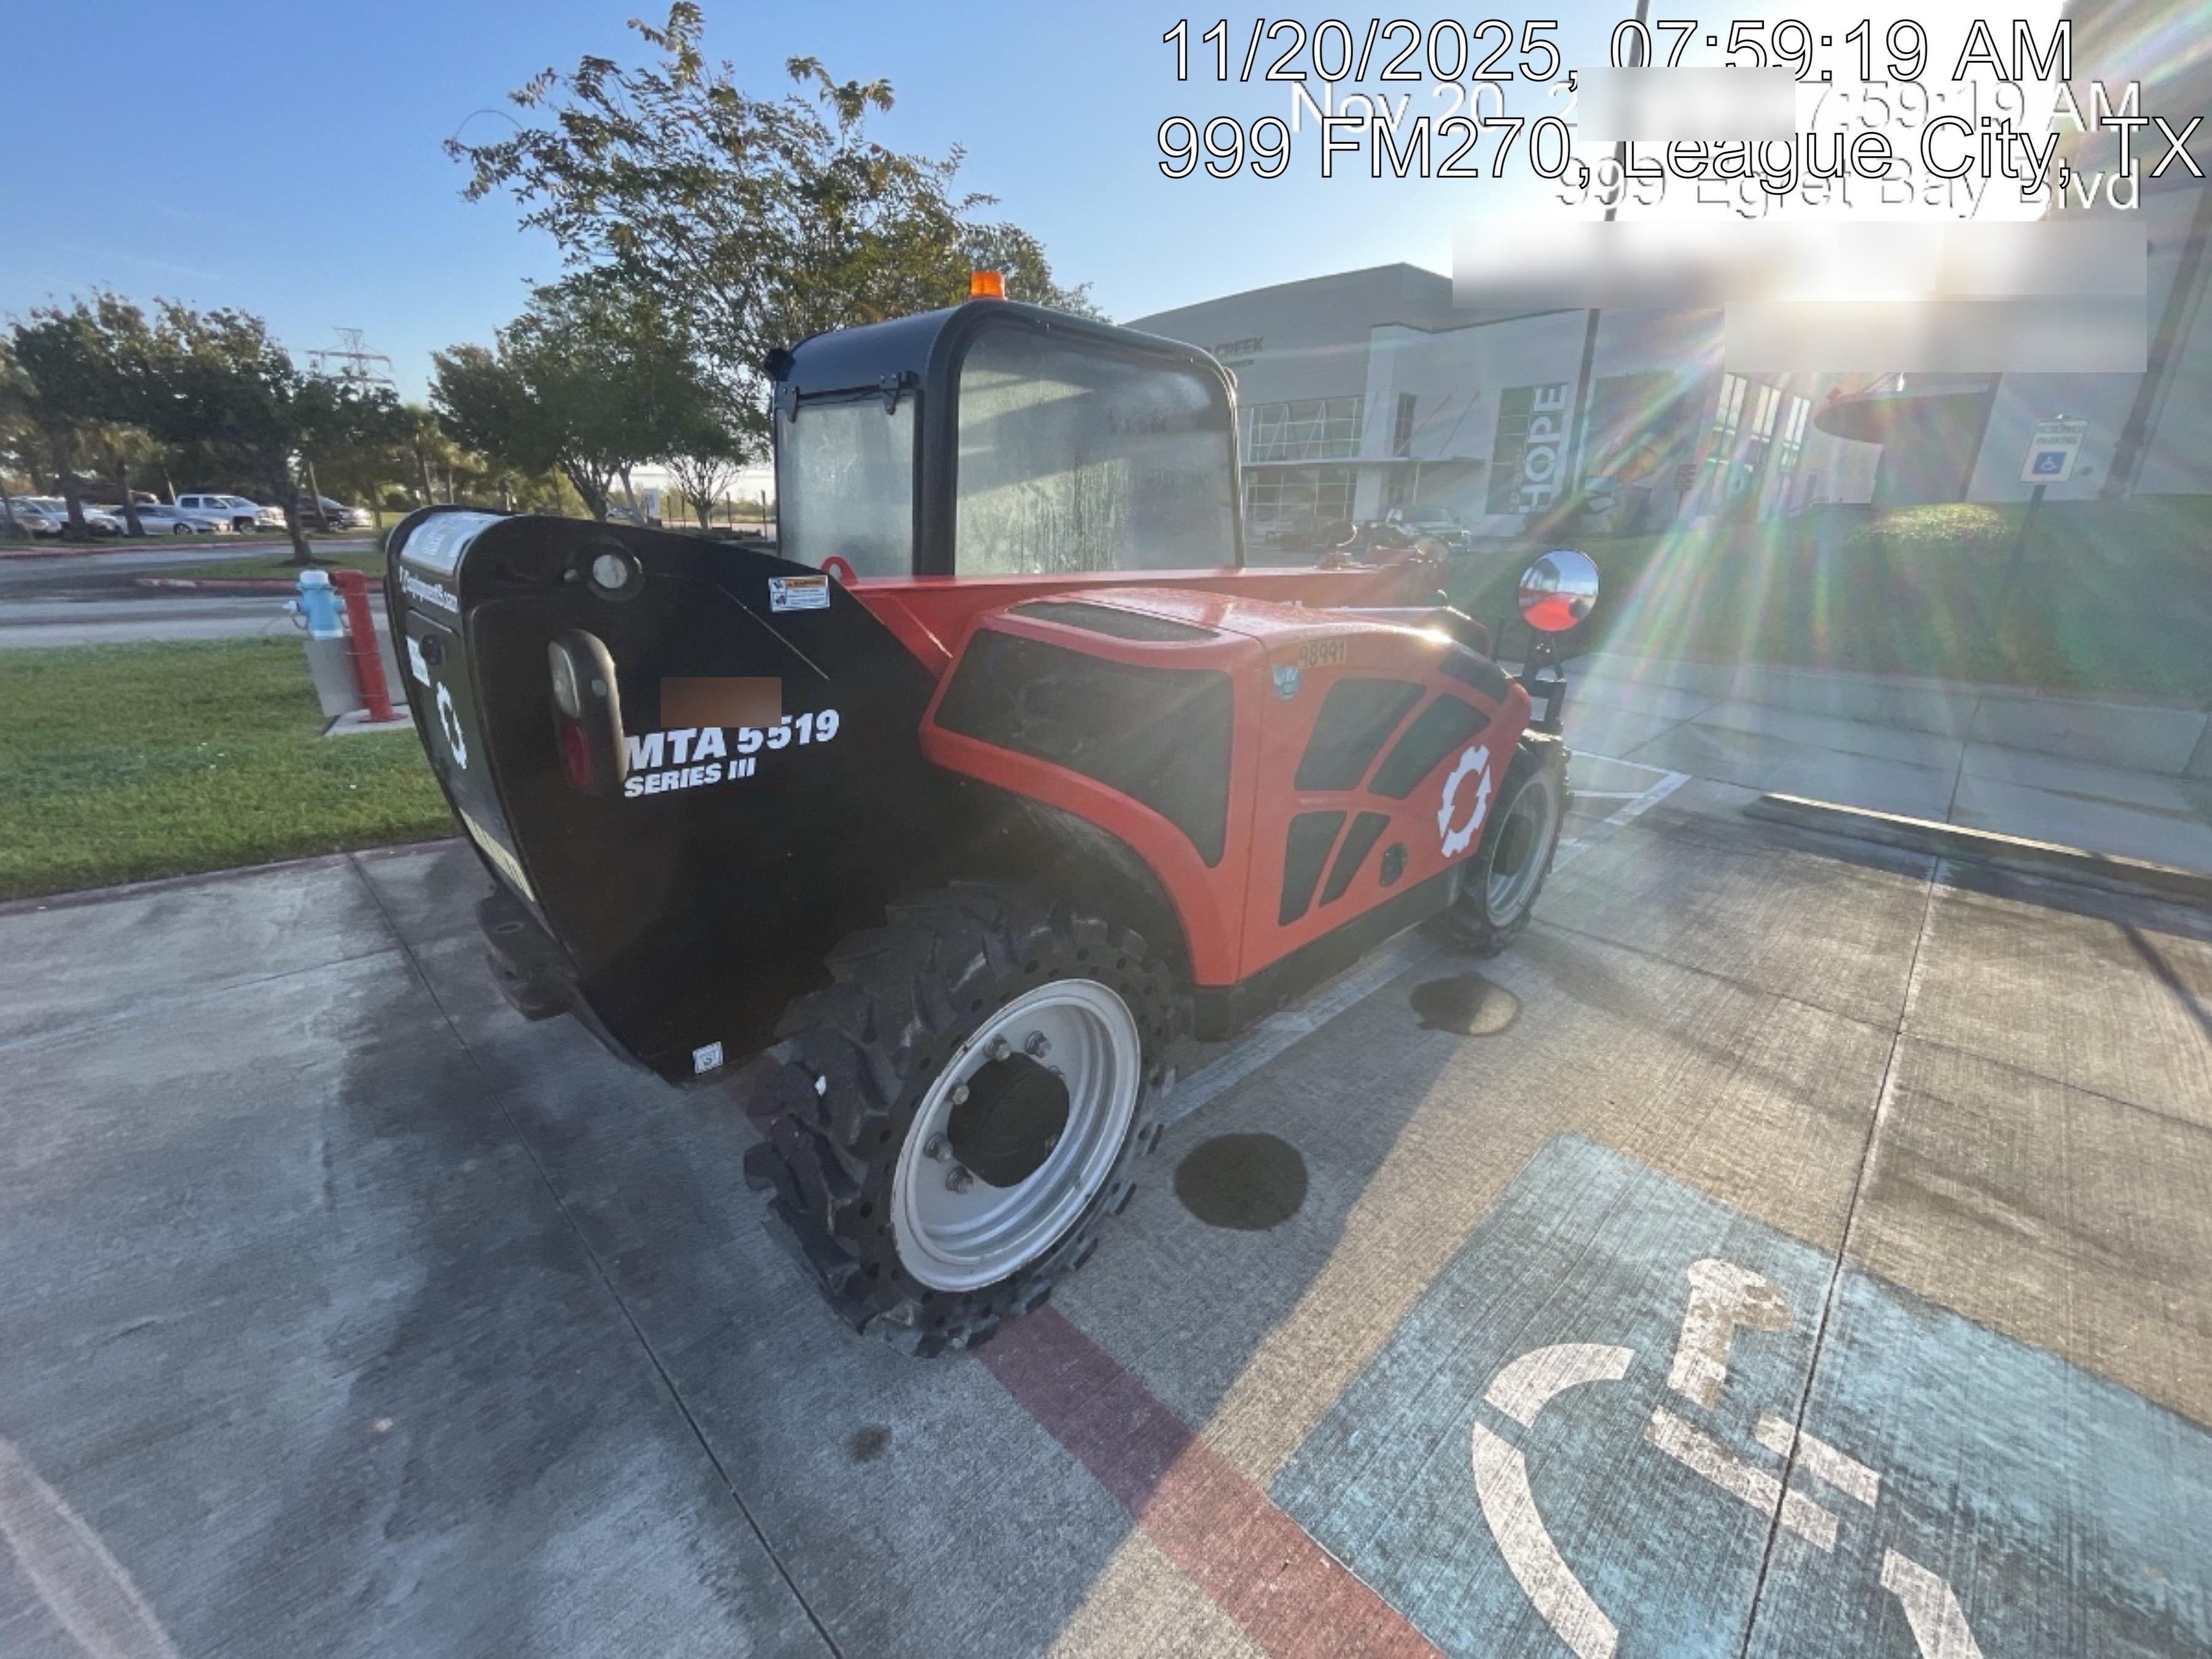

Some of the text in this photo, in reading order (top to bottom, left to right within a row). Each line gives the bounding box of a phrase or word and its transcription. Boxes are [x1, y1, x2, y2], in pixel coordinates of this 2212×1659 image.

[1518, 385, 1568, 514] HOPE
[624, 709, 840, 771] MTA 5519
[624, 757, 757, 798] SERIES III
